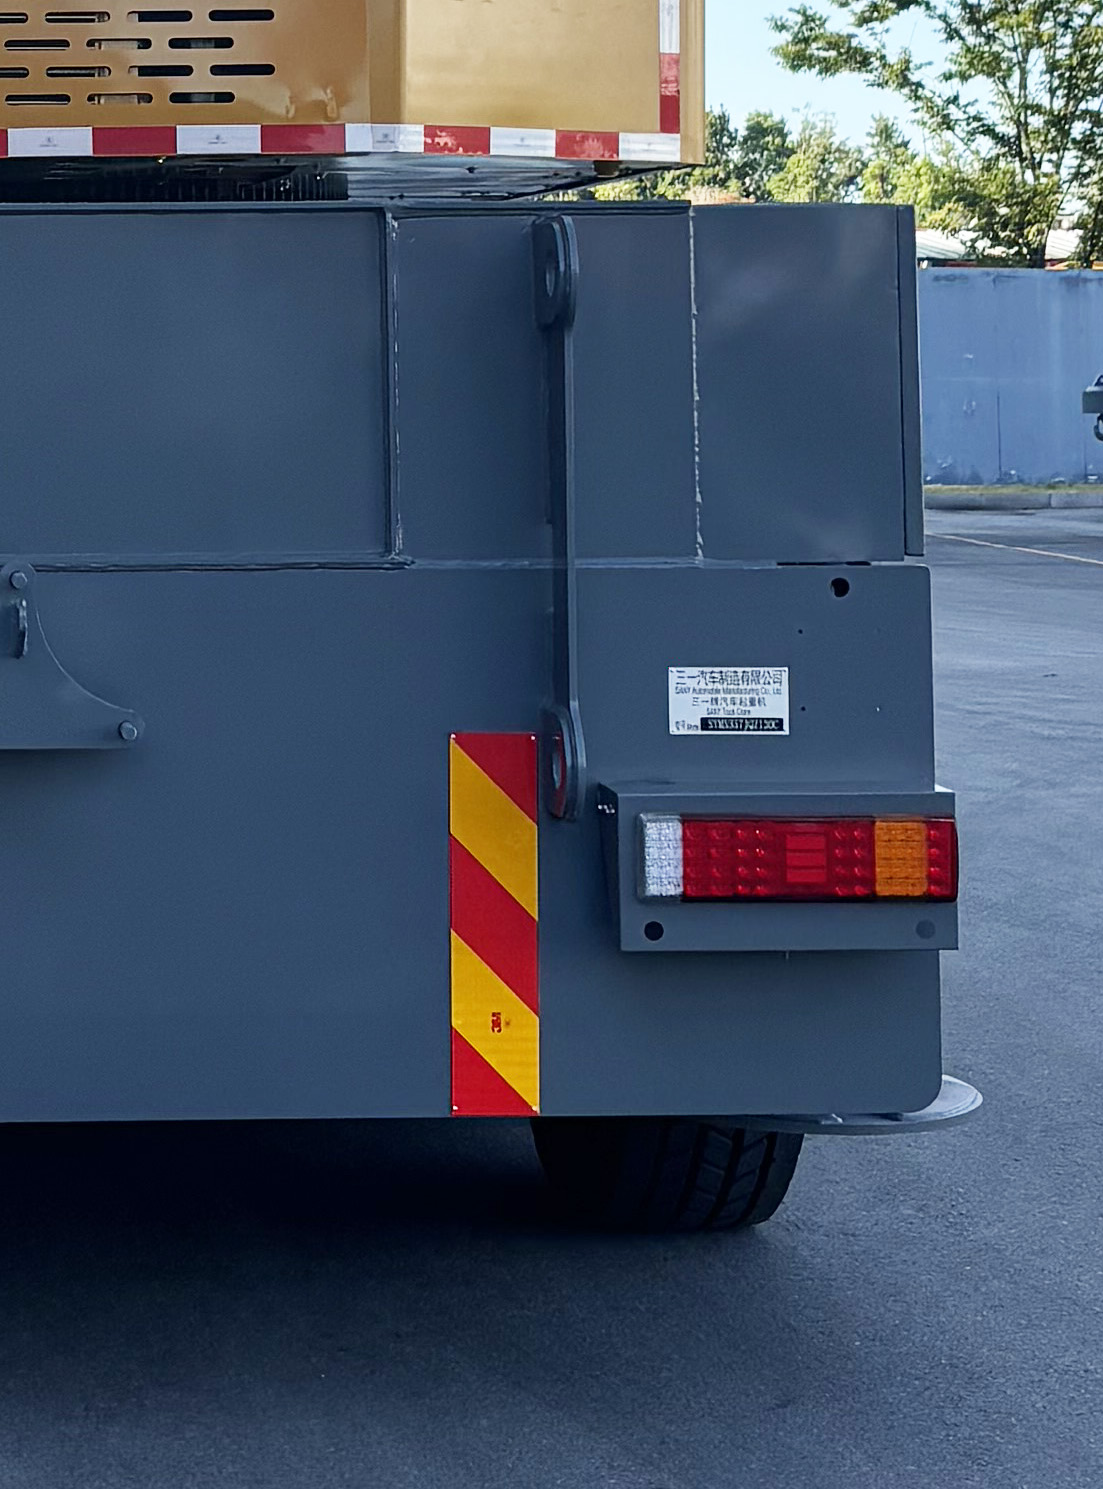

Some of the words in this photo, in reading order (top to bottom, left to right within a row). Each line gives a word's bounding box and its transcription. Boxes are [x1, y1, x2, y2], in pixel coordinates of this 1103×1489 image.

[675, 669, 783, 686] 三一汽车制造有限公司
